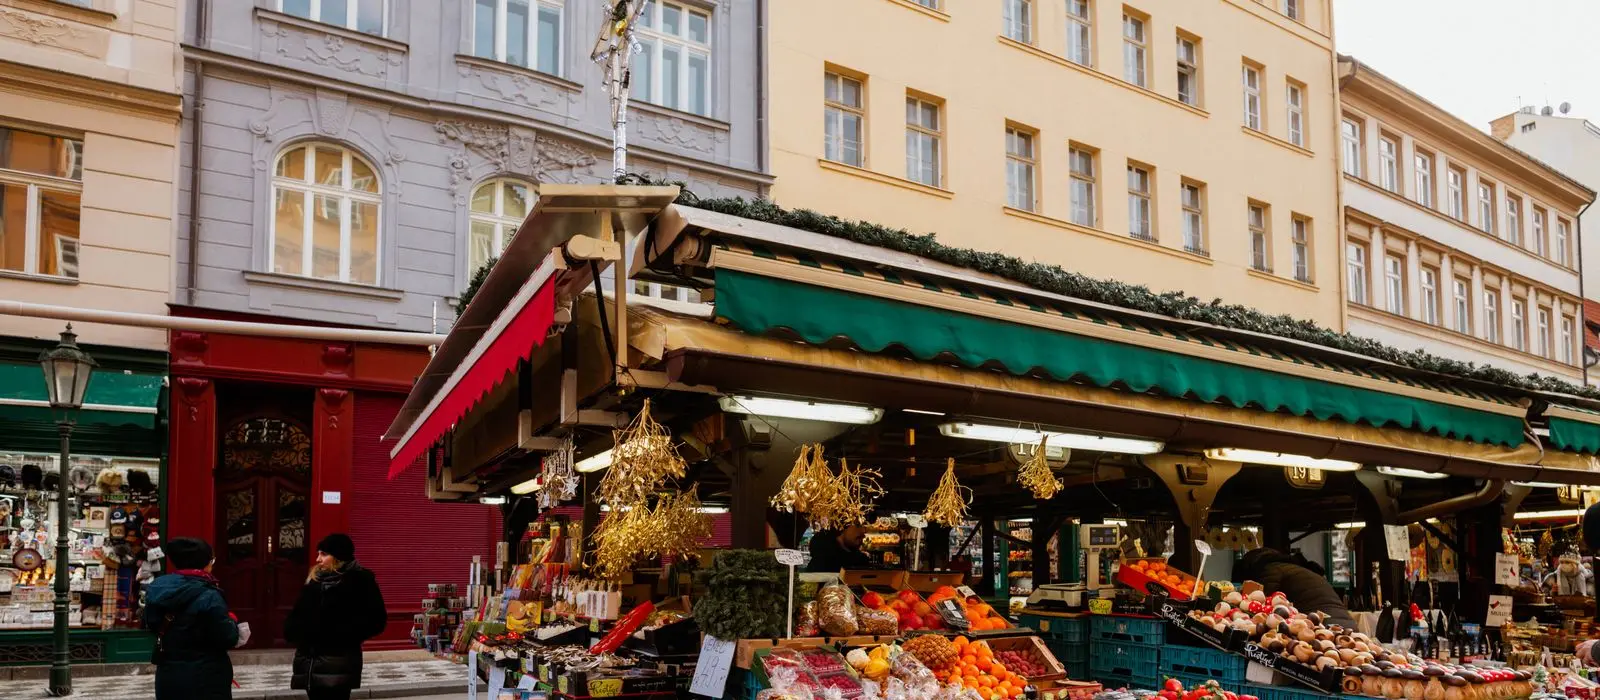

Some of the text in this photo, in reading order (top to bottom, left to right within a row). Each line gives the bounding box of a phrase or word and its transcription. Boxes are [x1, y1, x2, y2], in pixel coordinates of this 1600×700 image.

[1293, 466, 1306, 479] 19
[1281, 665, 1320, 687] SPECIAL SELECTION
